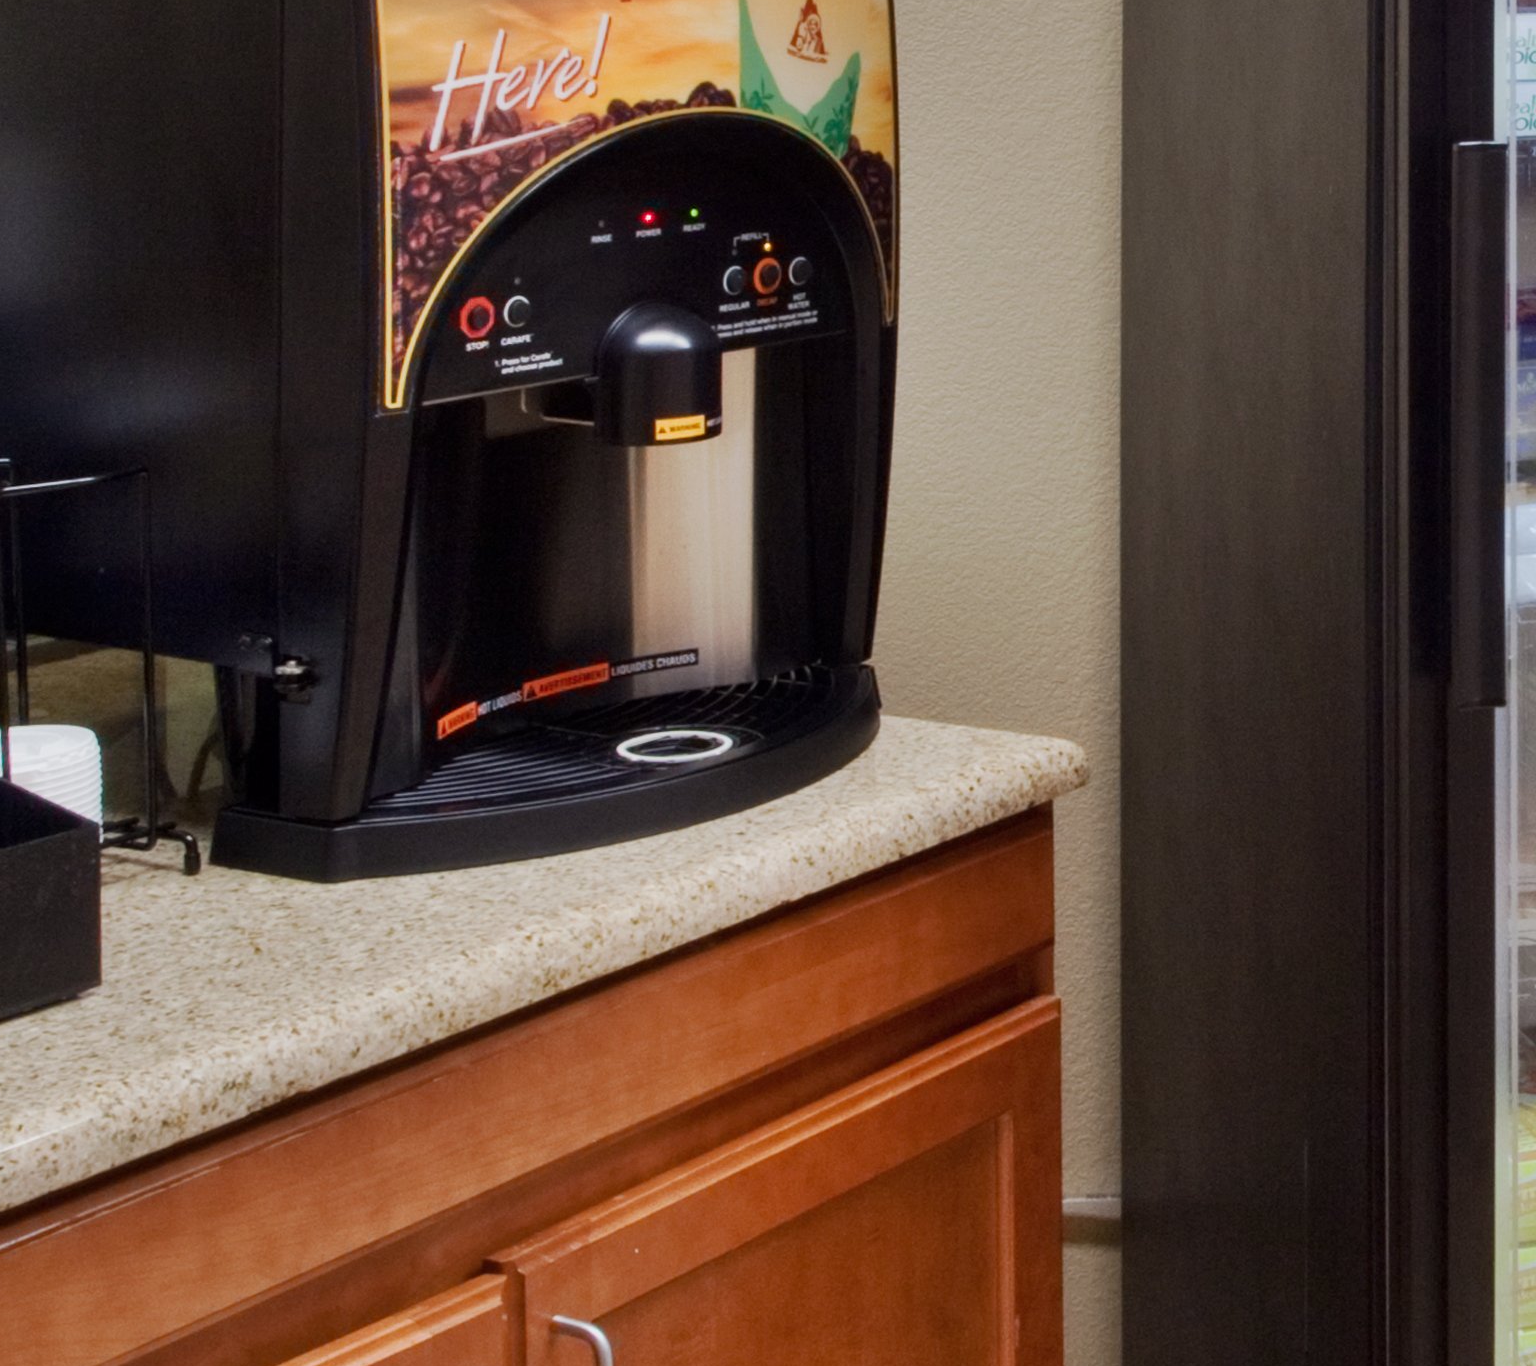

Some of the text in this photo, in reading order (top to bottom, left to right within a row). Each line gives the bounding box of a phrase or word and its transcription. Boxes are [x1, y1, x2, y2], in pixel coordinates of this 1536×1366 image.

[429, 14, 609, 153] Here!
[635, 228, 661, 238] POWER
[683, 223, 705, 232] READY
[719, 301, 750, 313] REGULAR
[500, 334, 532, 346] CARAFE
[611, 659, 654, 676] LIQUIDES
[656, 652, 696, 668] CHAUDS
